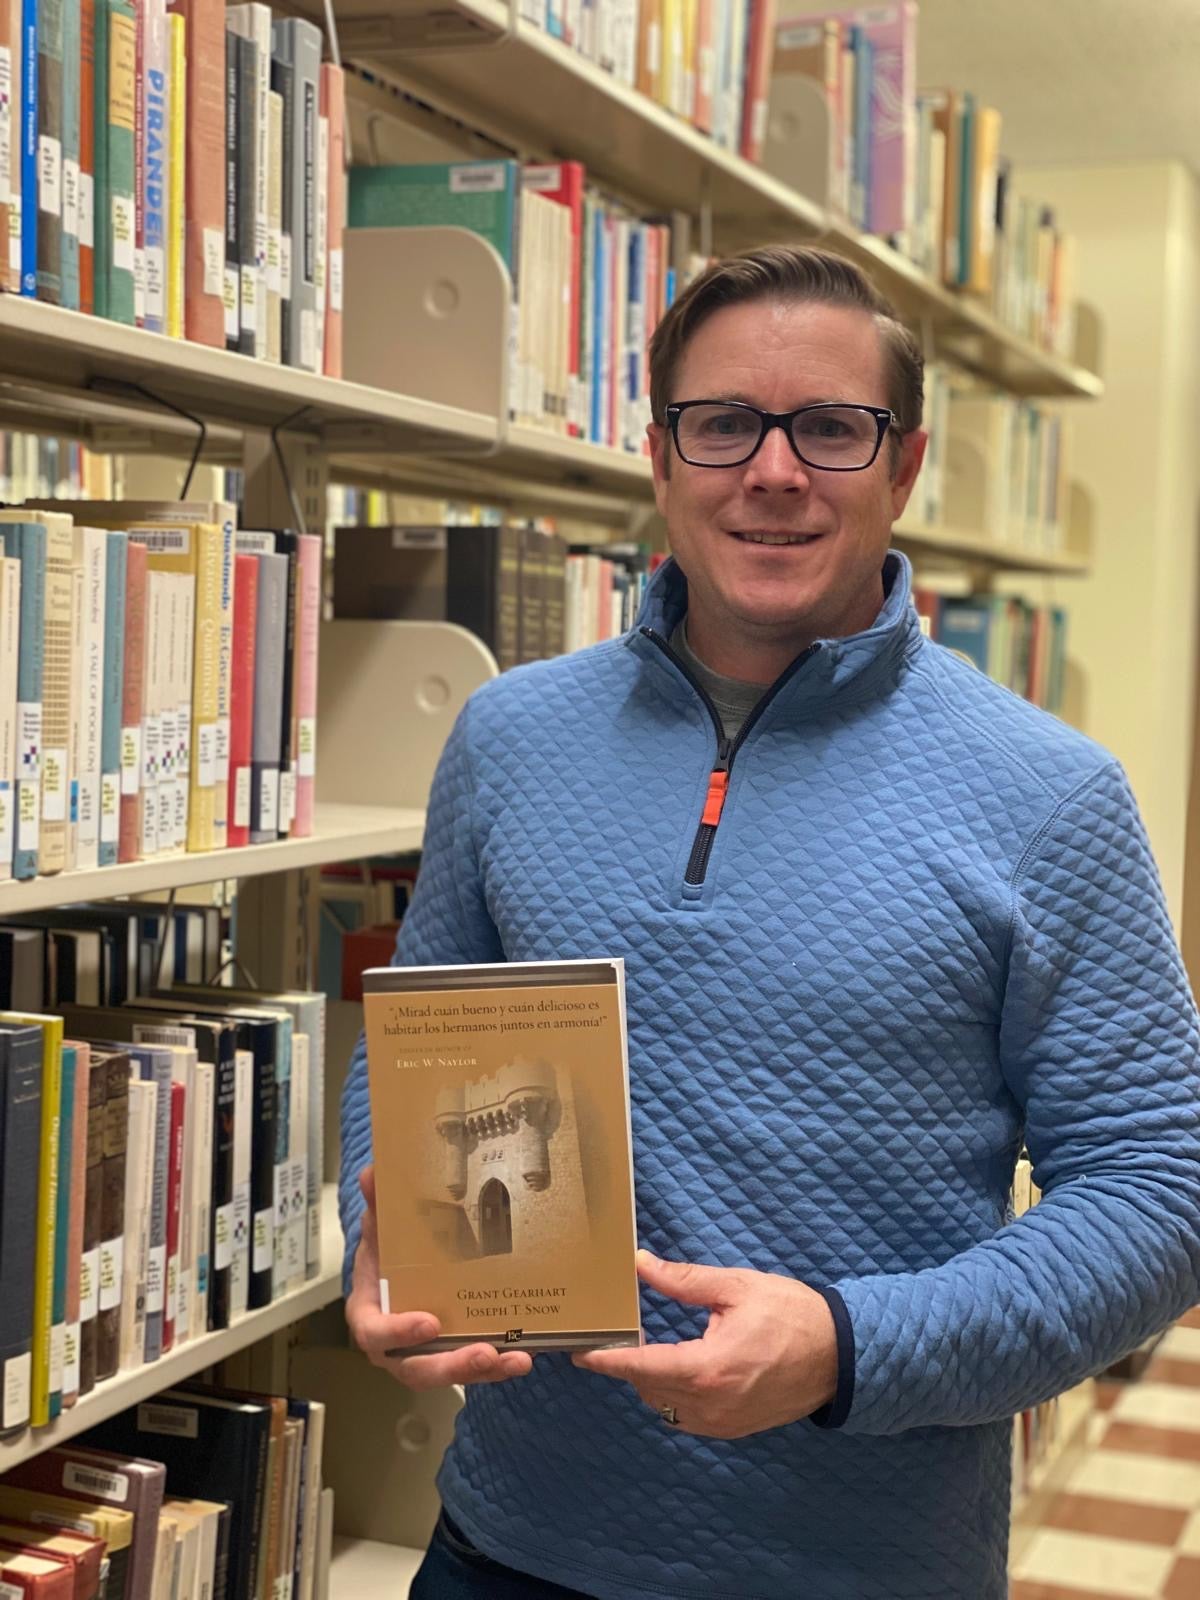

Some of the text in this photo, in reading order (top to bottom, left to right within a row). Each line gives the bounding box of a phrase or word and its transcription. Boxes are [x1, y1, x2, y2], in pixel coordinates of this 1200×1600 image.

[204, 532, 218, 610] Salvatore
[221, 520, 233, 611] Quasimodo
[219, 626, 230, 642] To
[88, 655, 98, 682] TALE
[200, 618, 216, 716] Quasimodo
[218, 645, 230, 680] Give
[88, 685, 98, 700] OF
[217, 686, 229, 717] and
[88, 705, 97, 742] POOR
[433, 1004, 460, 1017] cuán
[462, 1003, 497, 1016] bueno
[499, 1006, 506, 1016] y
[508, 1001, 535, 1014] cuán
[537, 999, 586, 1012] delicioso
[588, 1001, 600, 1011] es
[384, 1023, 423, 1036] habitar
[425, 1021, 440, 1034] los
[443, 1020, 498, 1034] hermanos
[499, 1020, 535, 1034] juntos
[537, 1021, 551, 1029] en
[396, 1058, 420, 1069] ERIC
[438, 1056, 479, 1067] NAYLOR
[456, 1286, 568, 1301] GRANT GEARHART
[466, 1306, 508, 1319] JOSEPH
[525, 1304, 561, 1315] SNOW
